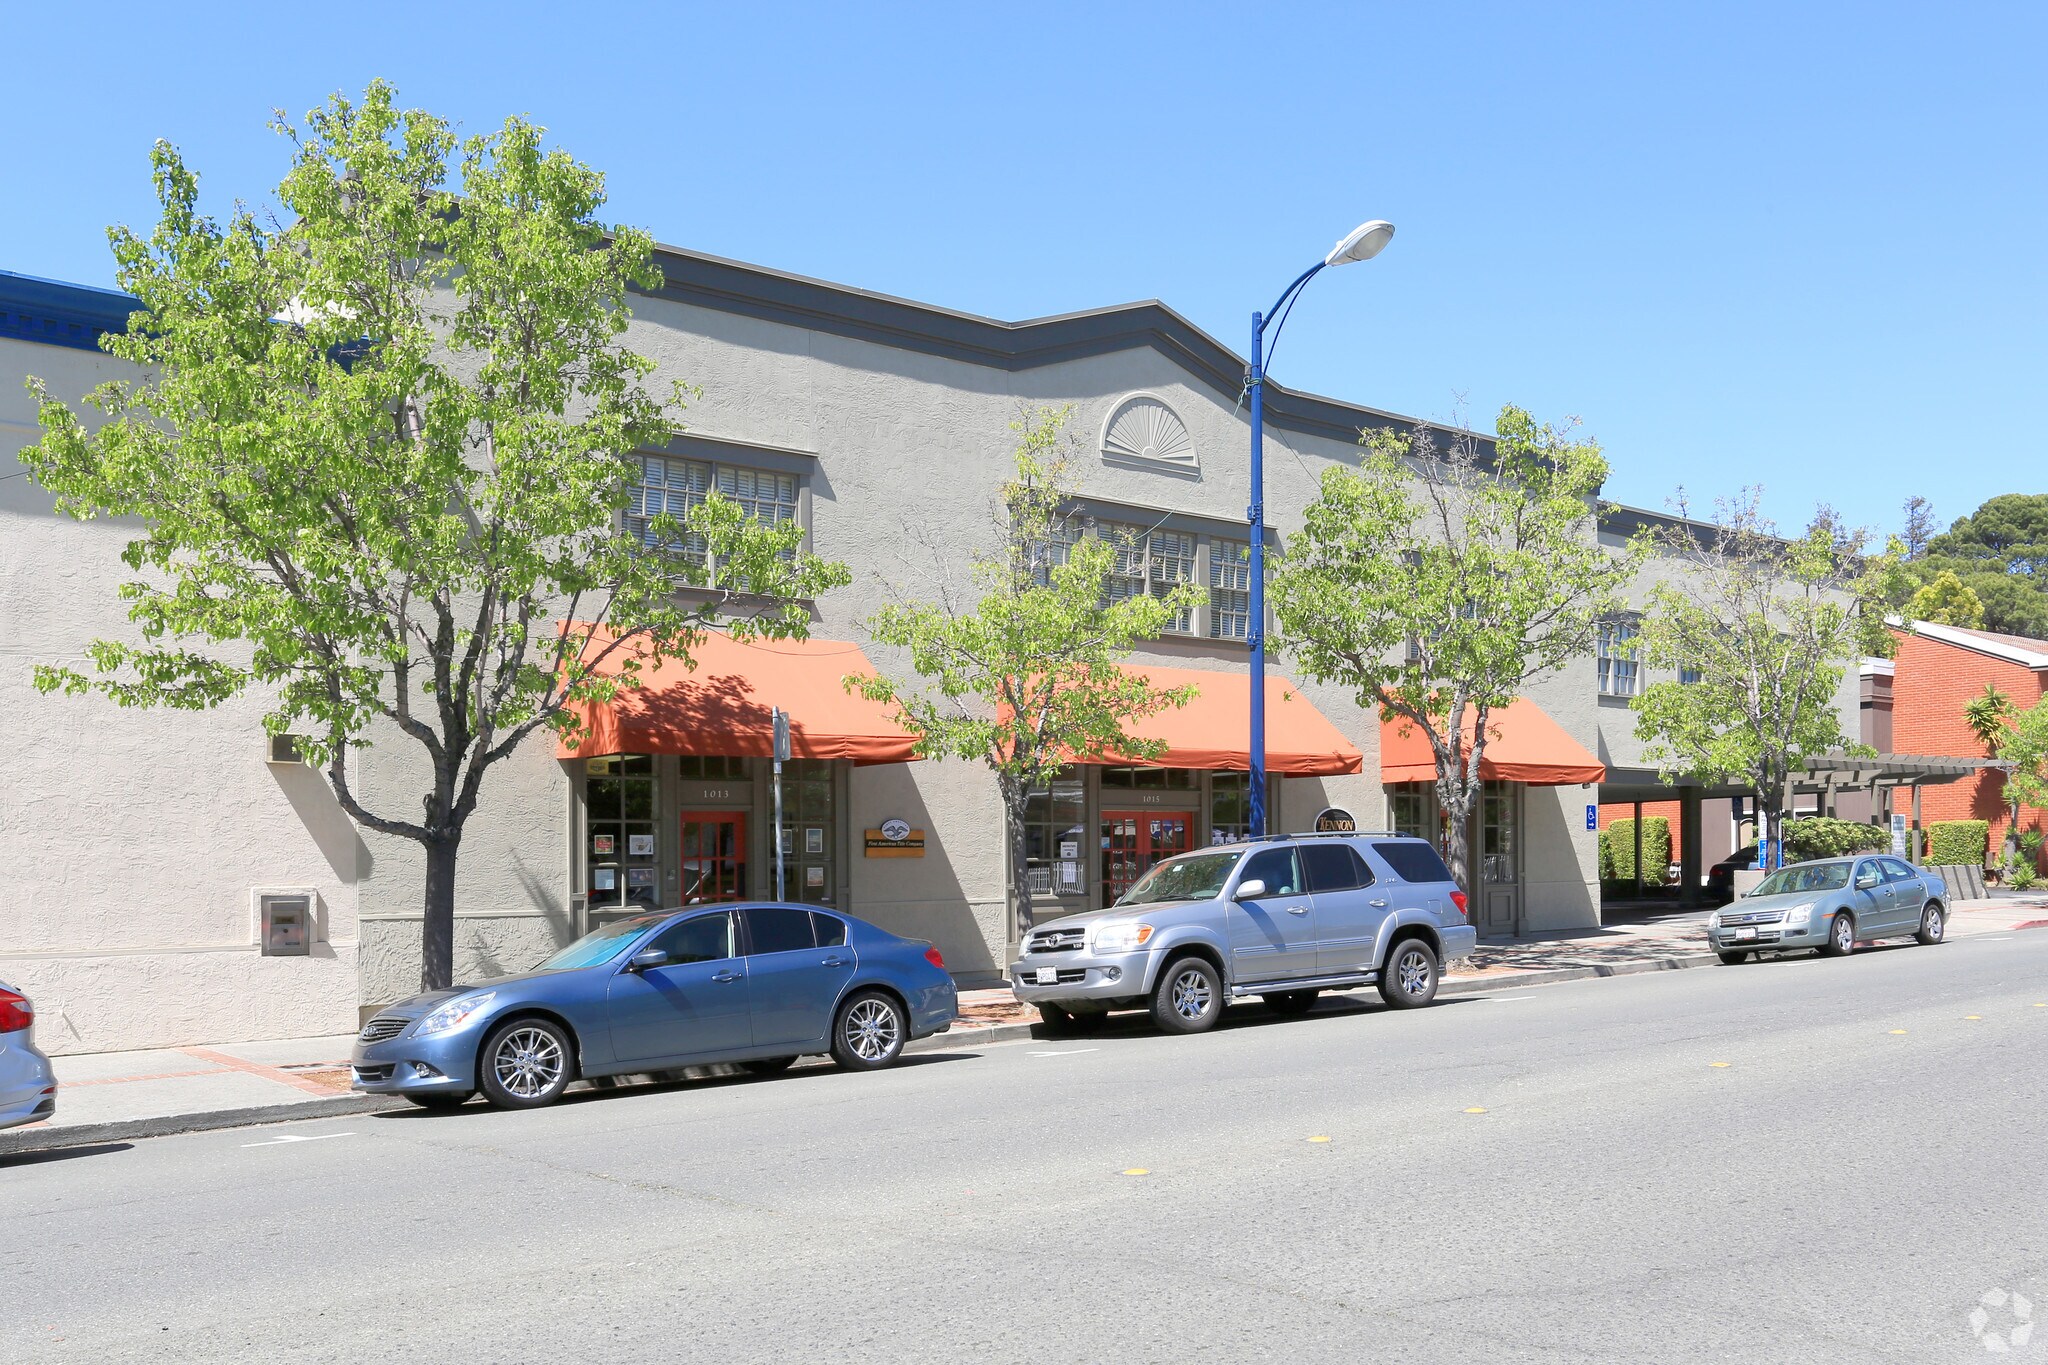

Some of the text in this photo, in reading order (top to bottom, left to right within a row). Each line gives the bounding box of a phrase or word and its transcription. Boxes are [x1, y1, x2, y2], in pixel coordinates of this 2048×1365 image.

[704, 790, 729, 798] 1013
[1143, 795, 1160, 803] 1015
[1319, 817, 1354, 831] KENNON
